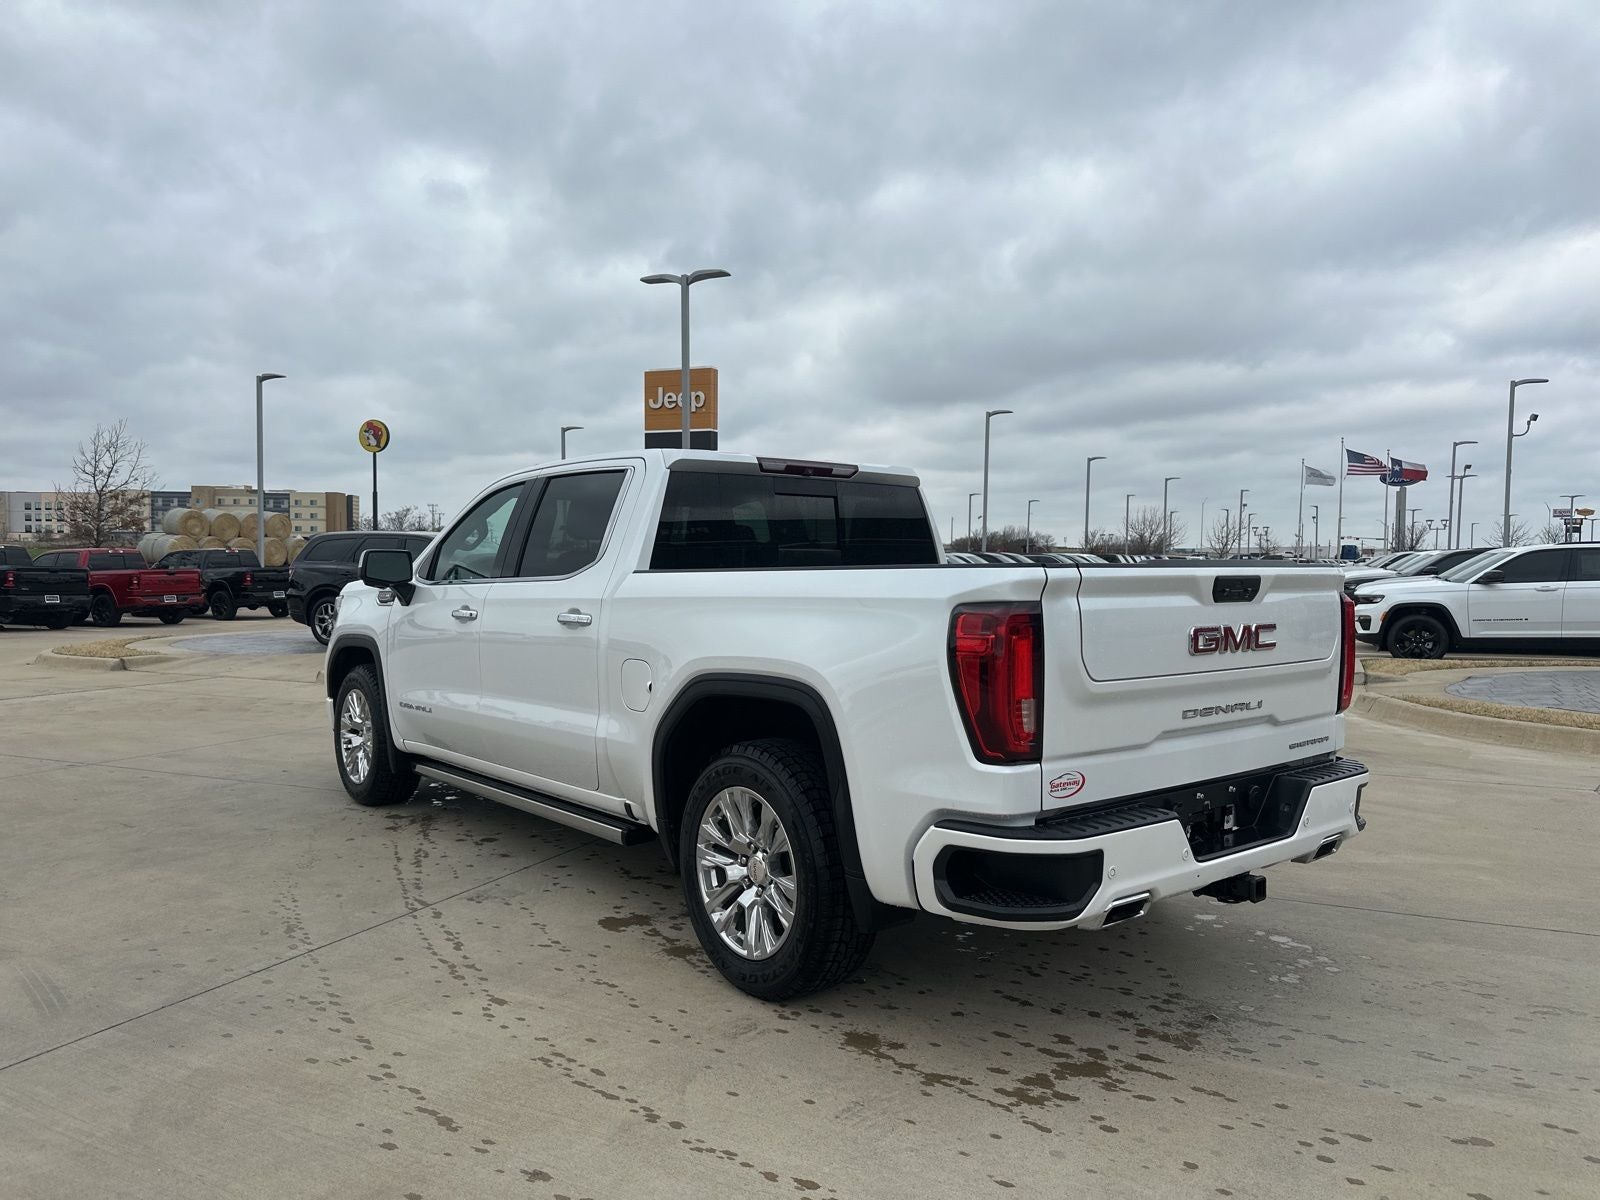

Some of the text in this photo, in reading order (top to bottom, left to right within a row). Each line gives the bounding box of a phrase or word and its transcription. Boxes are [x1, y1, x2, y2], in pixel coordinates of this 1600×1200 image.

[1188, 623, 1277, 656] GMC
[1182, 700, 1263, 720] DENALI
[1050, 780, 1081, 789] Gateway
